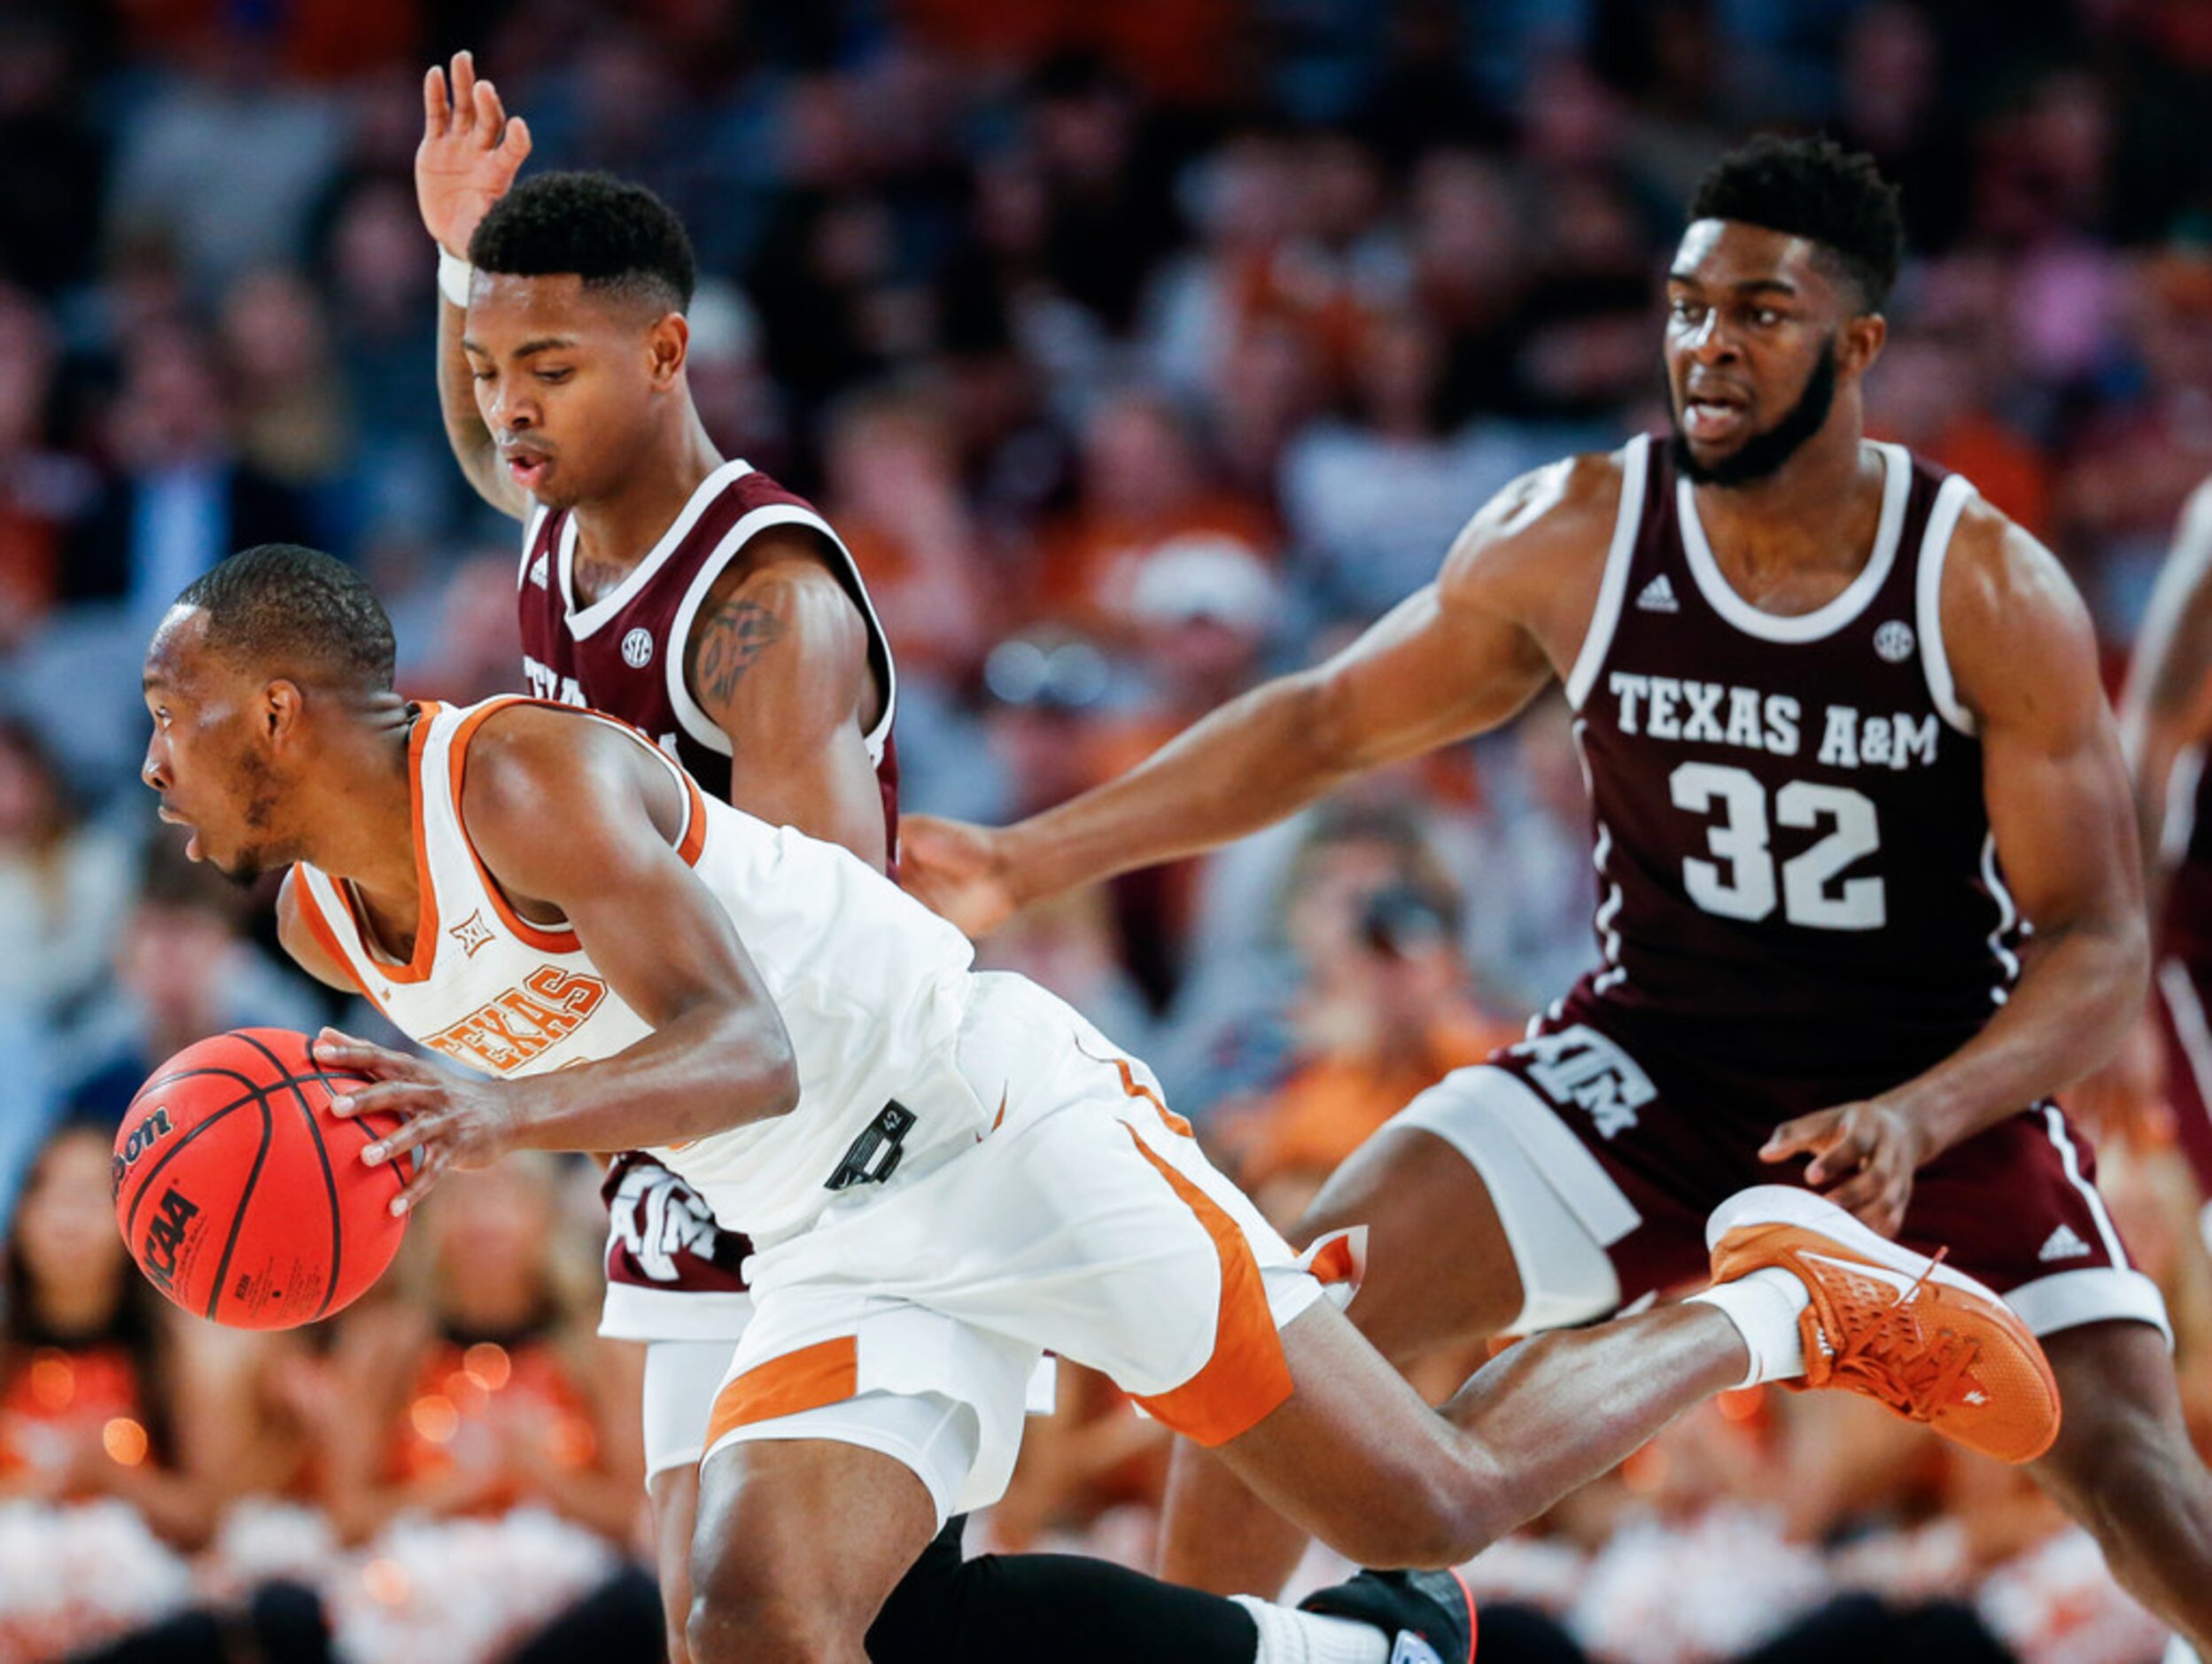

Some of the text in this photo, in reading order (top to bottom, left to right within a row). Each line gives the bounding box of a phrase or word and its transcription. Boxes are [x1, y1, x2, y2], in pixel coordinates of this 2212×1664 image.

[1610, 672, 1939, 770] TEXAS A&M
[1670, 761, 1886, 930] 32
